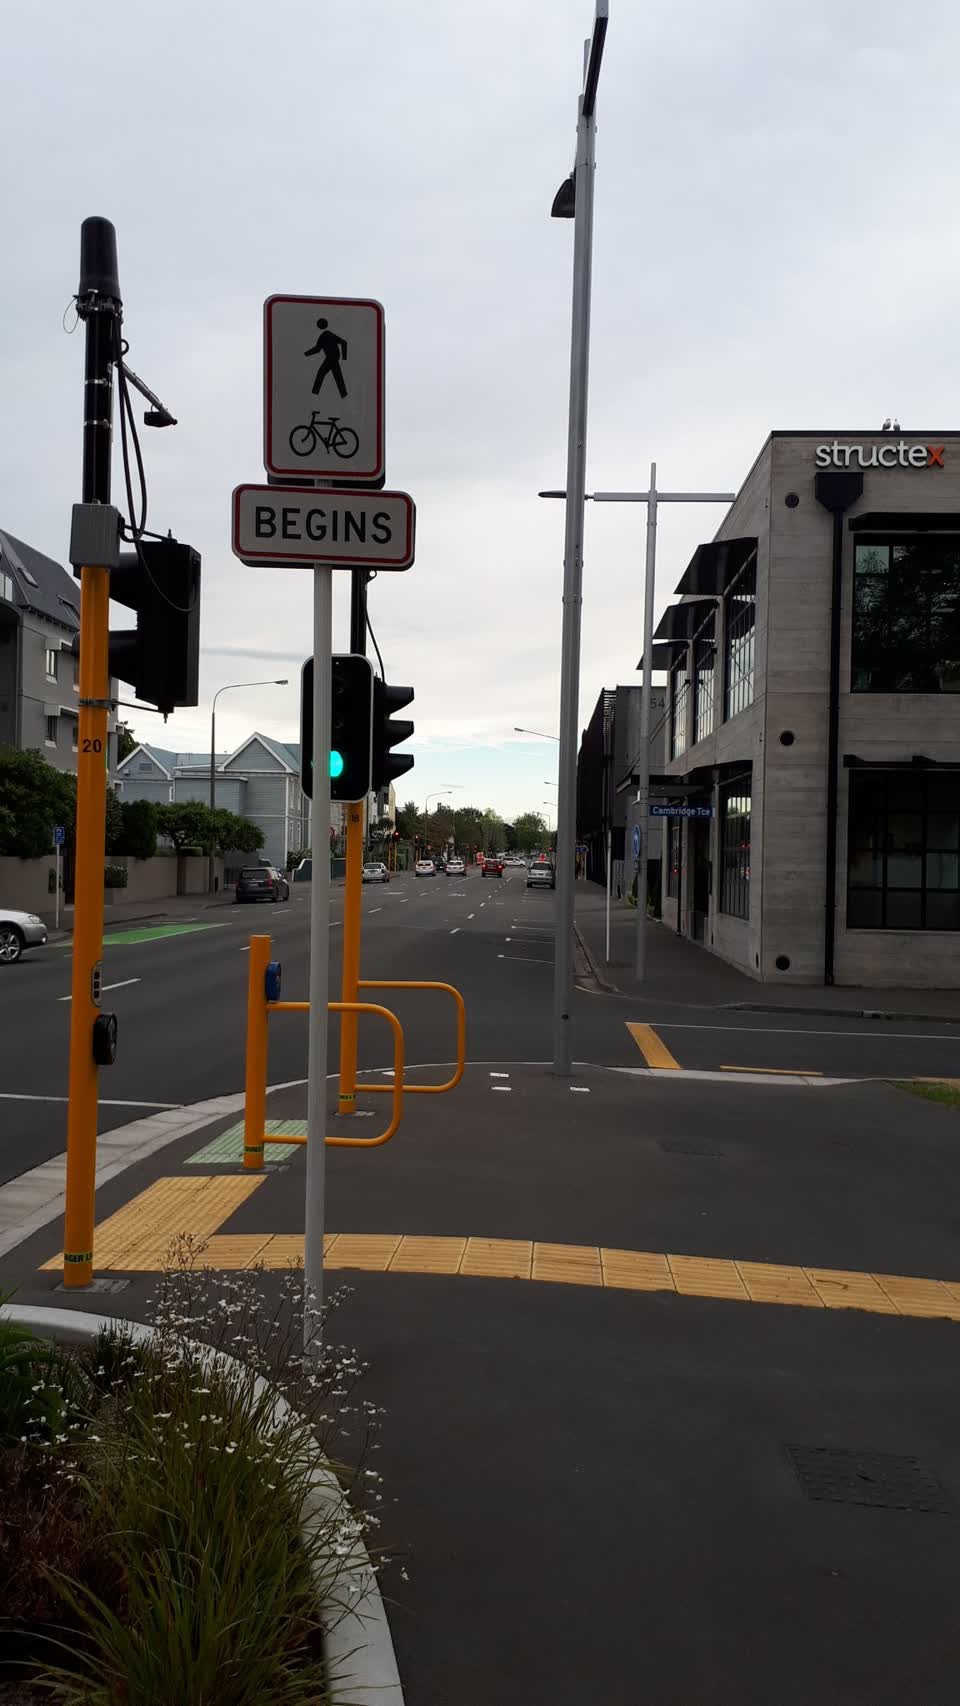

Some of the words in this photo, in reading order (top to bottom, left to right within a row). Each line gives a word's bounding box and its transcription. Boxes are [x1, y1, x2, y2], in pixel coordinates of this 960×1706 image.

[815, 440, 945, 467] structex
[255, 506, 392, 544] BEGINS
[650, 697, 665, 709] 54
[82, 738, 102, 753] 20
[652, 806, 696, 816] Cambridge
[697, 807, 710, 816] Tce
